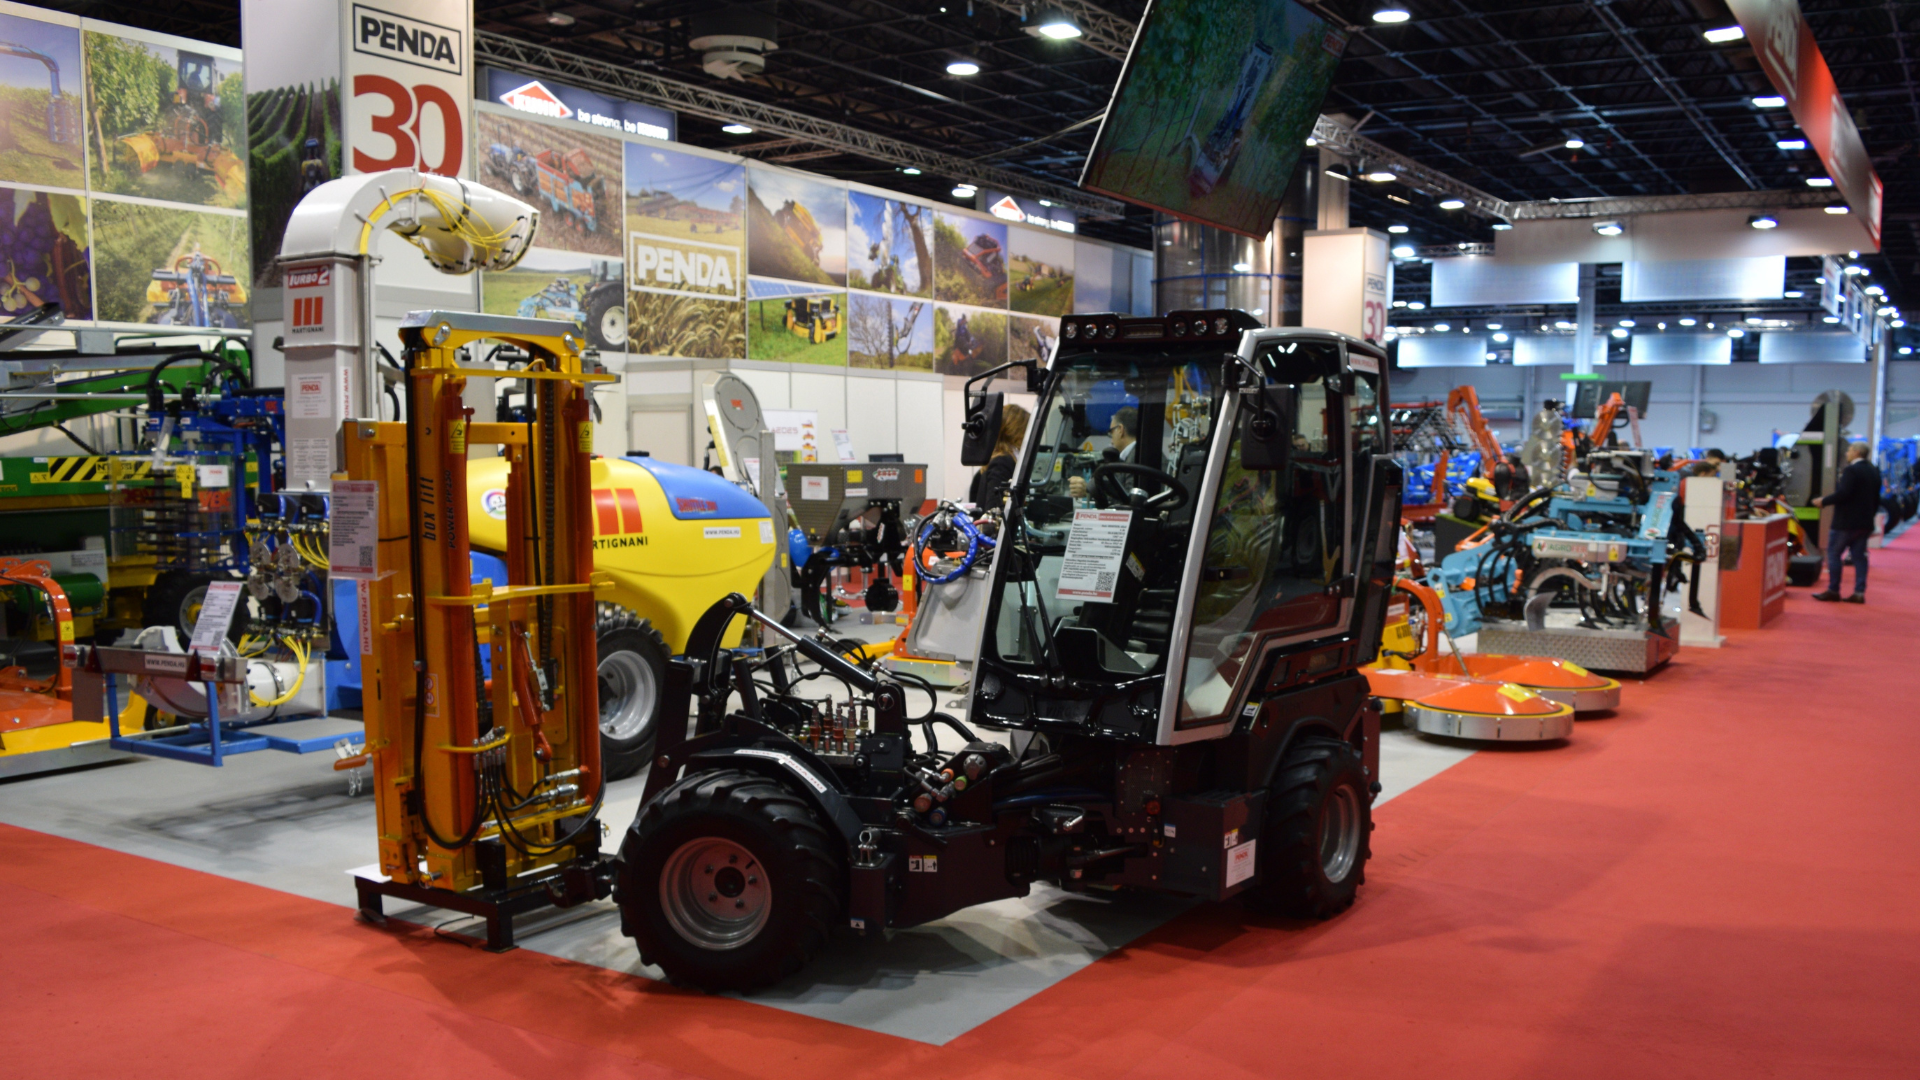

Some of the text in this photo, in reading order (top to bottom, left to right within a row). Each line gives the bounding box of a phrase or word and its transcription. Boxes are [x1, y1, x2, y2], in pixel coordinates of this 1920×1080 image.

[361, 15, 456, 65] PENDA
[353, 74, 463, 177] 30
[638, 244, 734, 290] PENDA
[1365, 300, 1384, 342] 30
[423, 511, 436, 540] box
[447, 506, 456, 548] POWER
